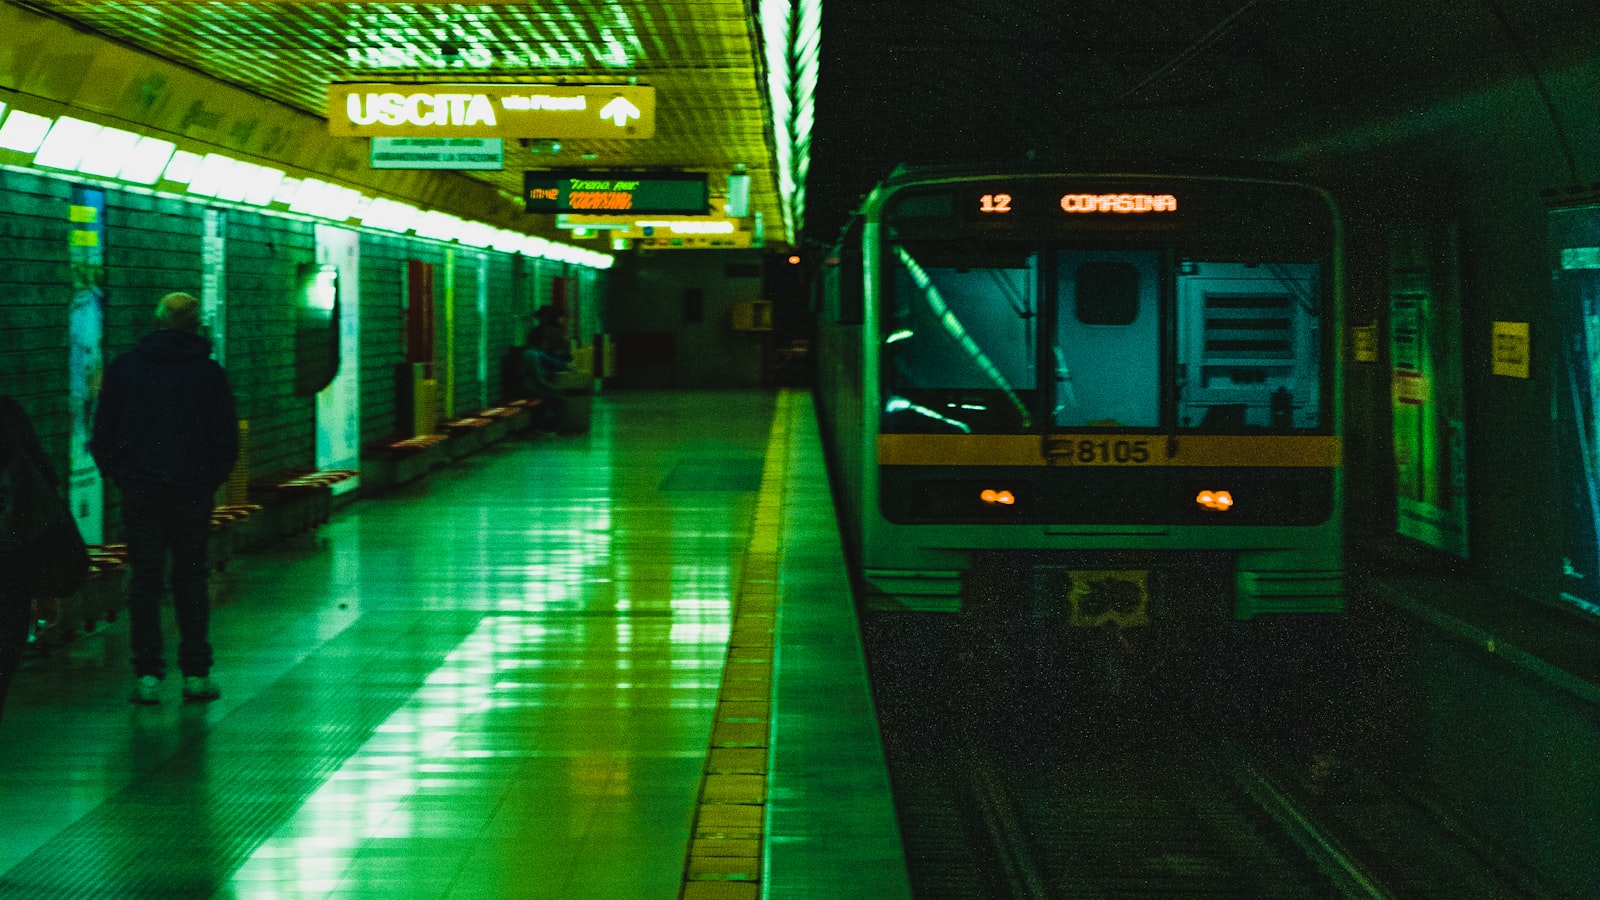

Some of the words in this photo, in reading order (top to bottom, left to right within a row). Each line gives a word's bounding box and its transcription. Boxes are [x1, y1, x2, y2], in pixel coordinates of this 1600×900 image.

[346, 93, 497, 126] USCITA
[979, 194, 1012, 212] 12
[1060, 194, 1178, 213] COMASINA
[1078, 440, 1150, 463] 8105
